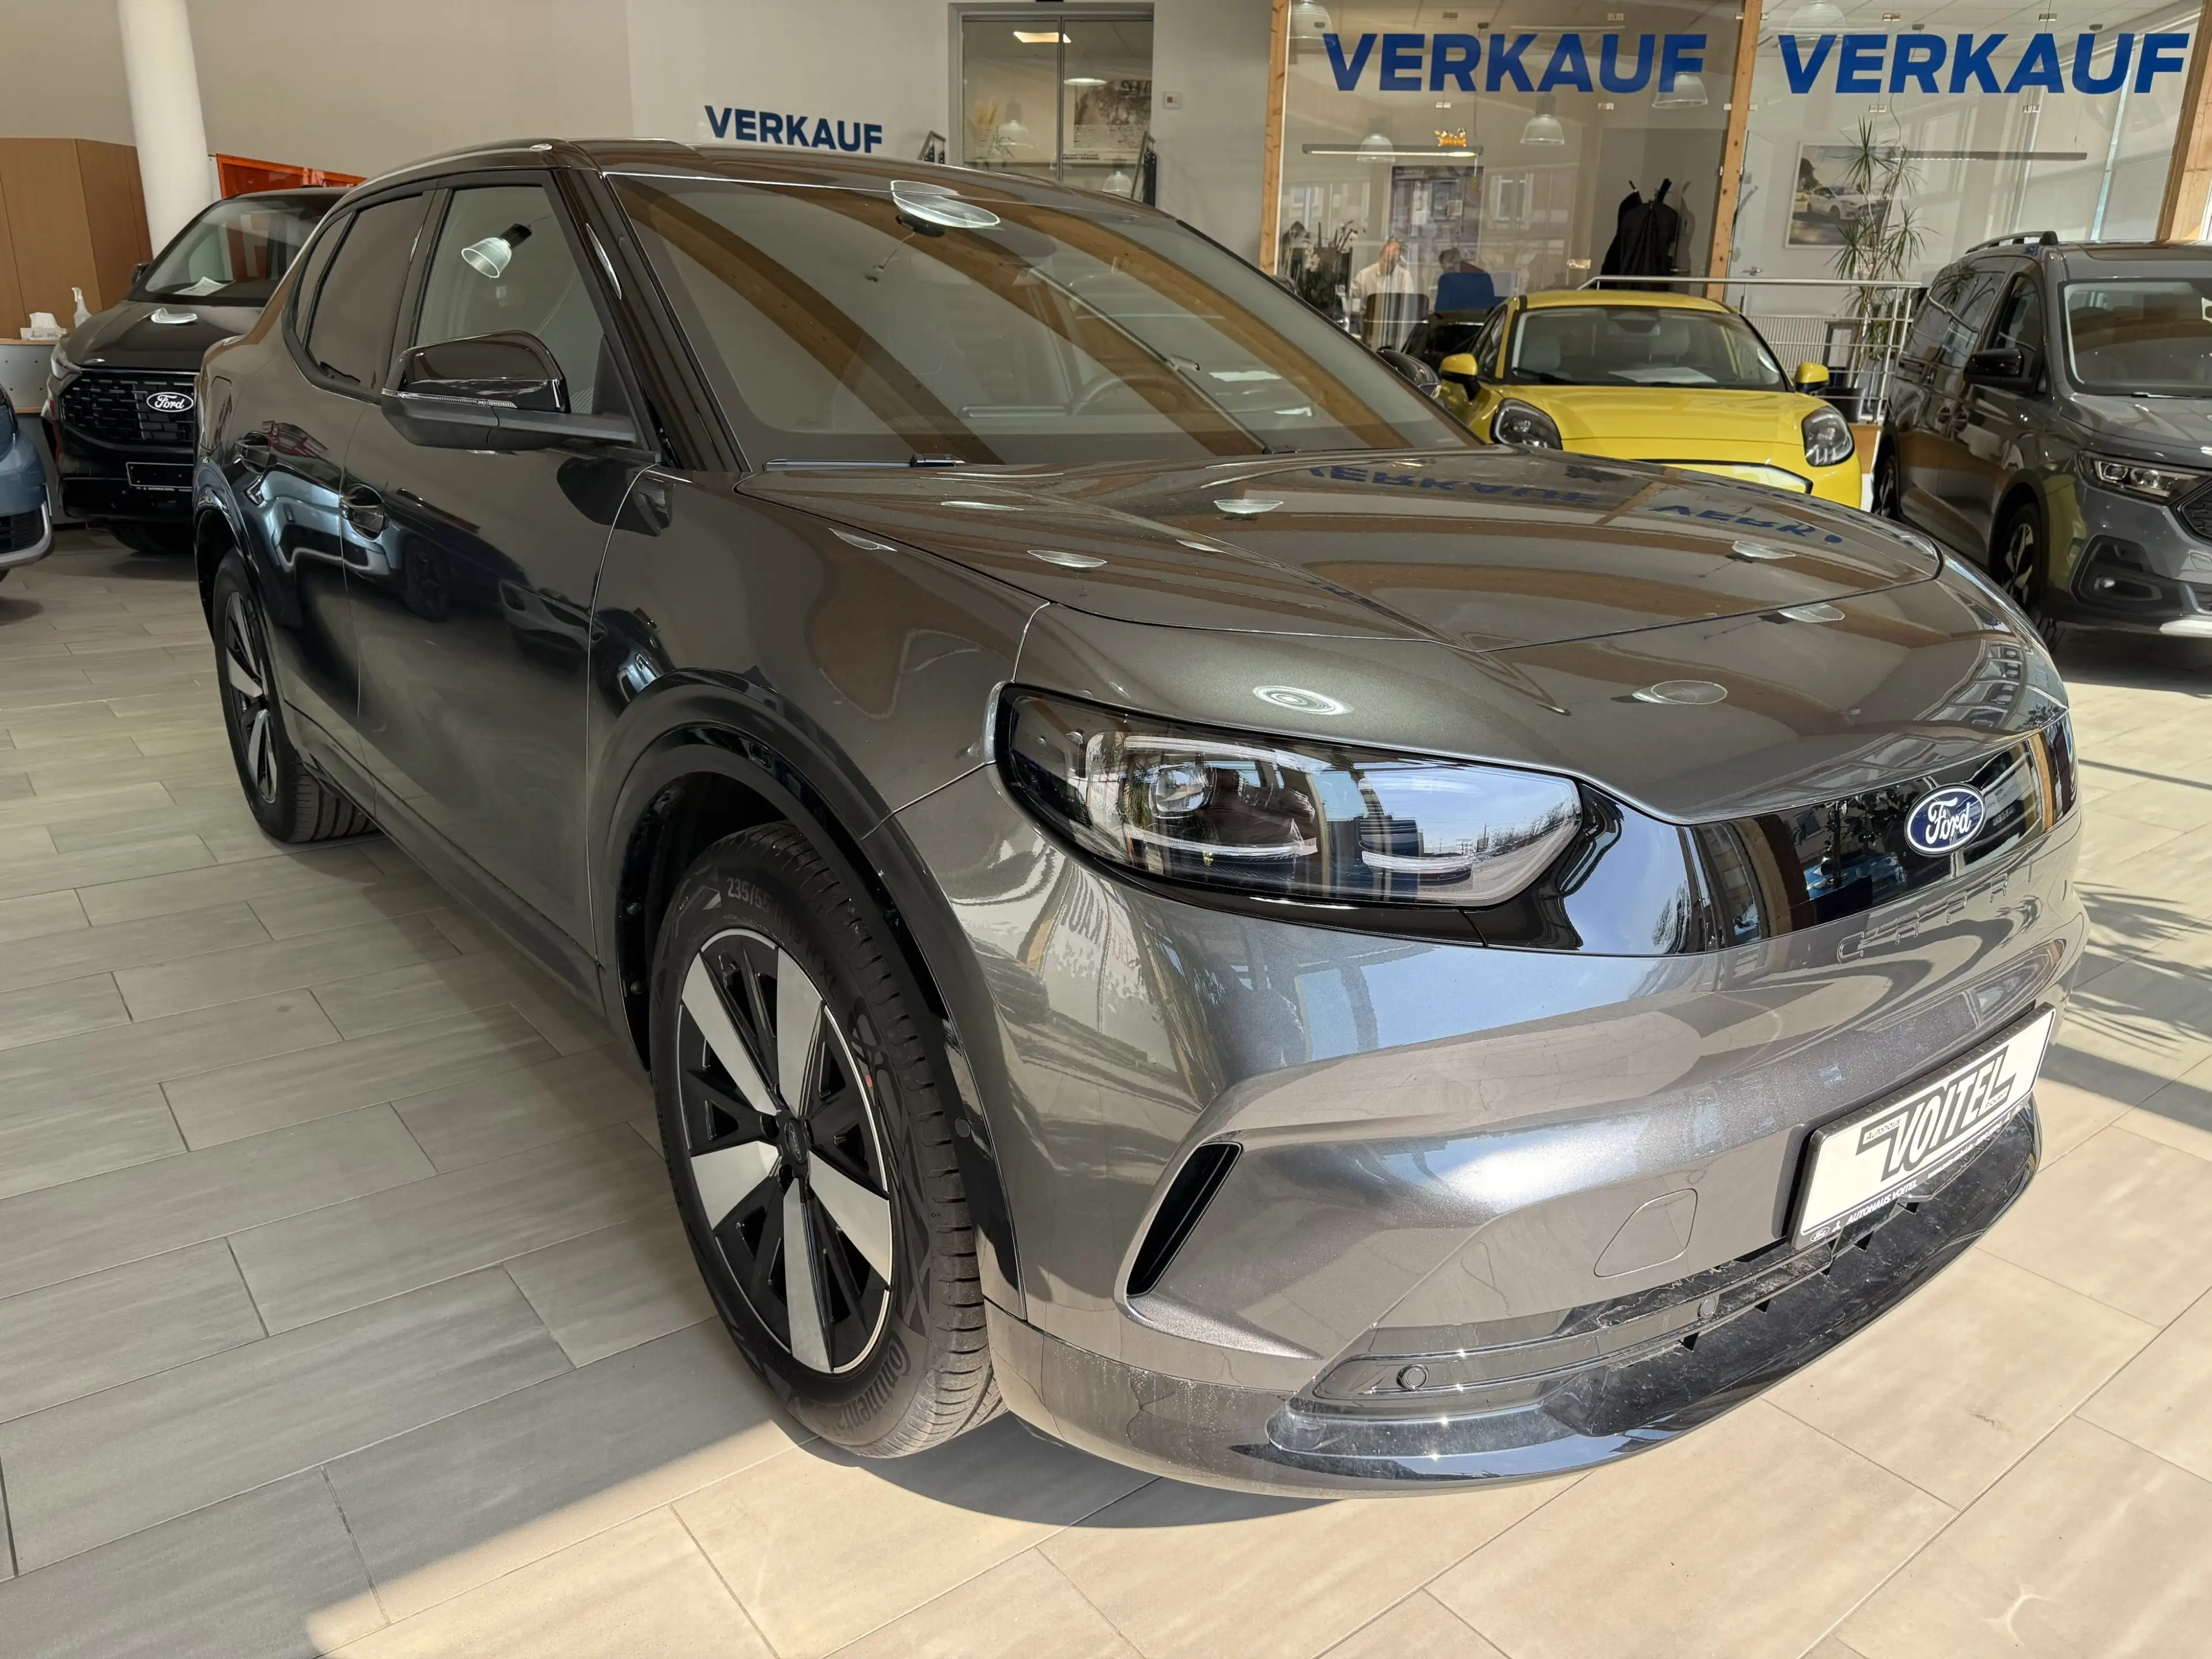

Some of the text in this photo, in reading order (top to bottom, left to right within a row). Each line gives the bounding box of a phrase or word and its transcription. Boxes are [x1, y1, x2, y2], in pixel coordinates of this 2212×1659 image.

[1323, 33, 1707, 93] VERKAUF
[1778, 33, 2190, 94] VERKAUF
[704, 105, 882, 153] VERKAUF
[154, 394, 185, 409] Ford
[1925, 797, 1972, 844] Ford
[1836, 859, 2033, 964] CAPRI
[1856, 1045, 2016, 1182] VOITEL
[1846, 1193, 1892, 1225] AUTOHAUS
